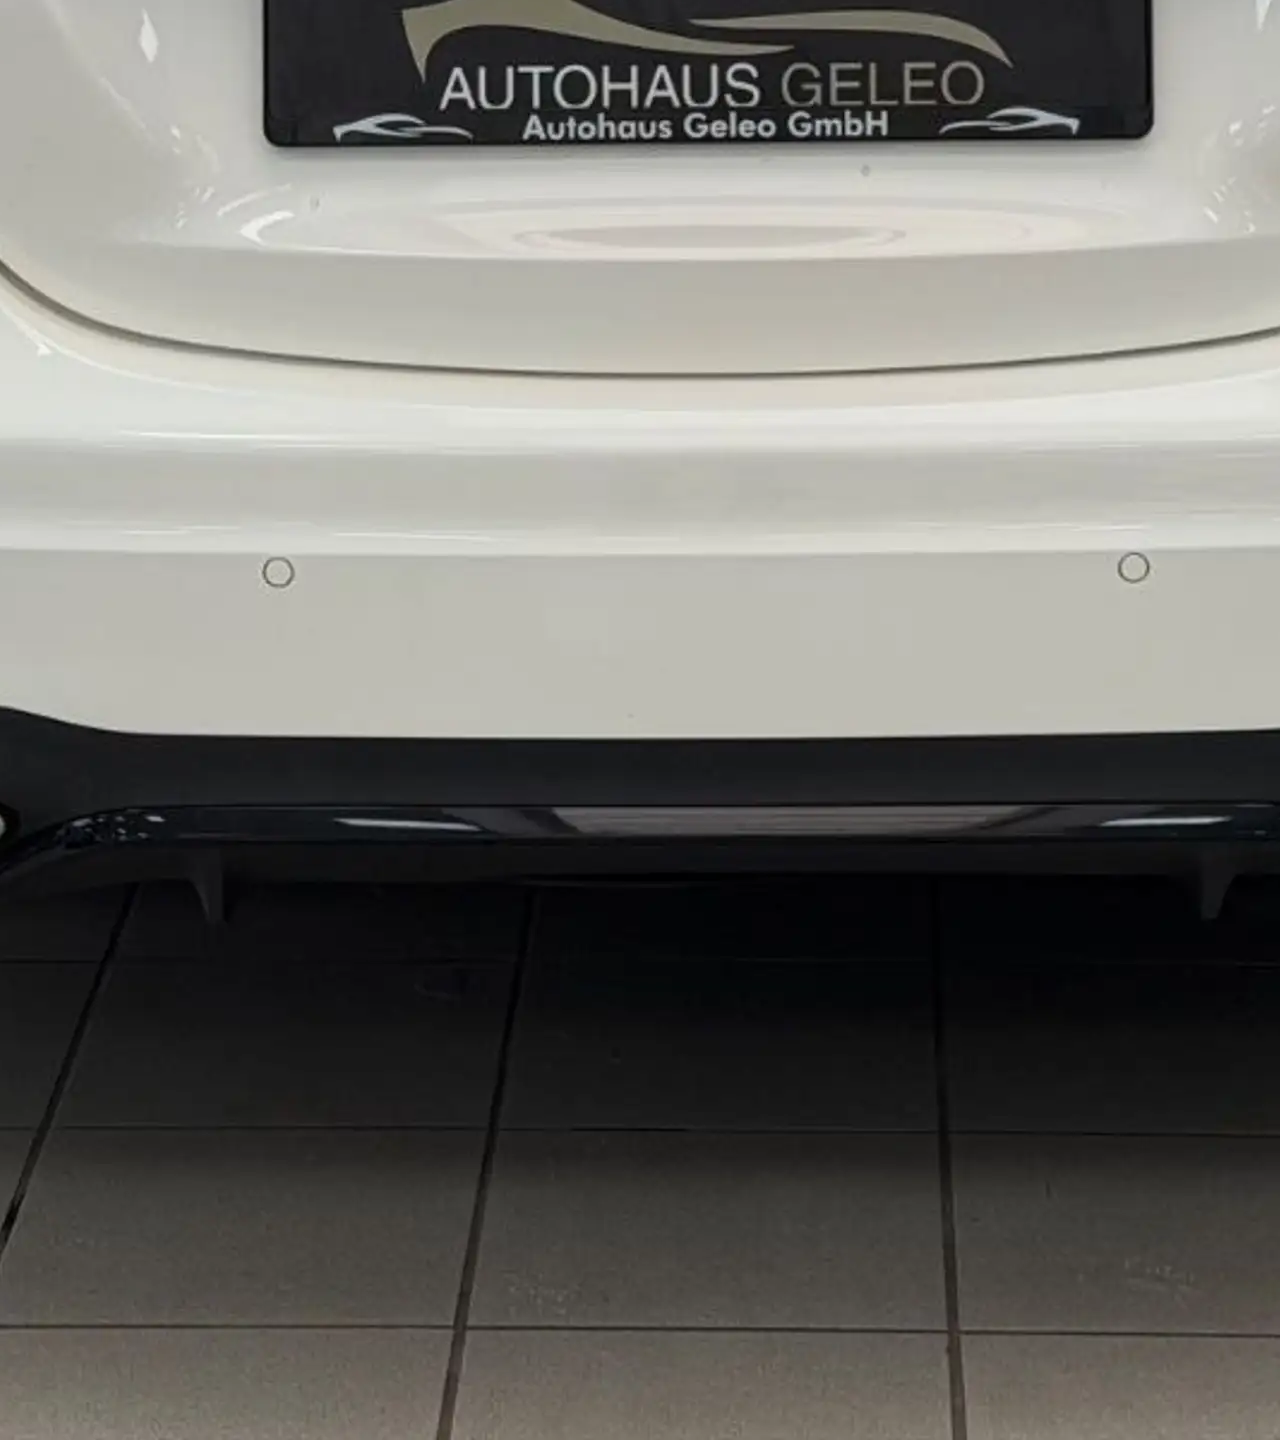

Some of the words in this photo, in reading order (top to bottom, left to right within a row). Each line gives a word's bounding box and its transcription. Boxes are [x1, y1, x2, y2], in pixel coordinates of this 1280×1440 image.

[439, 63, 761, 110] AUTOHAUS
[780, 60, 986, 108] GELEO
[522, 111, 673, 142] Autohaus
[683, 111, 777, 140] Geleo
[787, 109, 889, 139] GmbH
